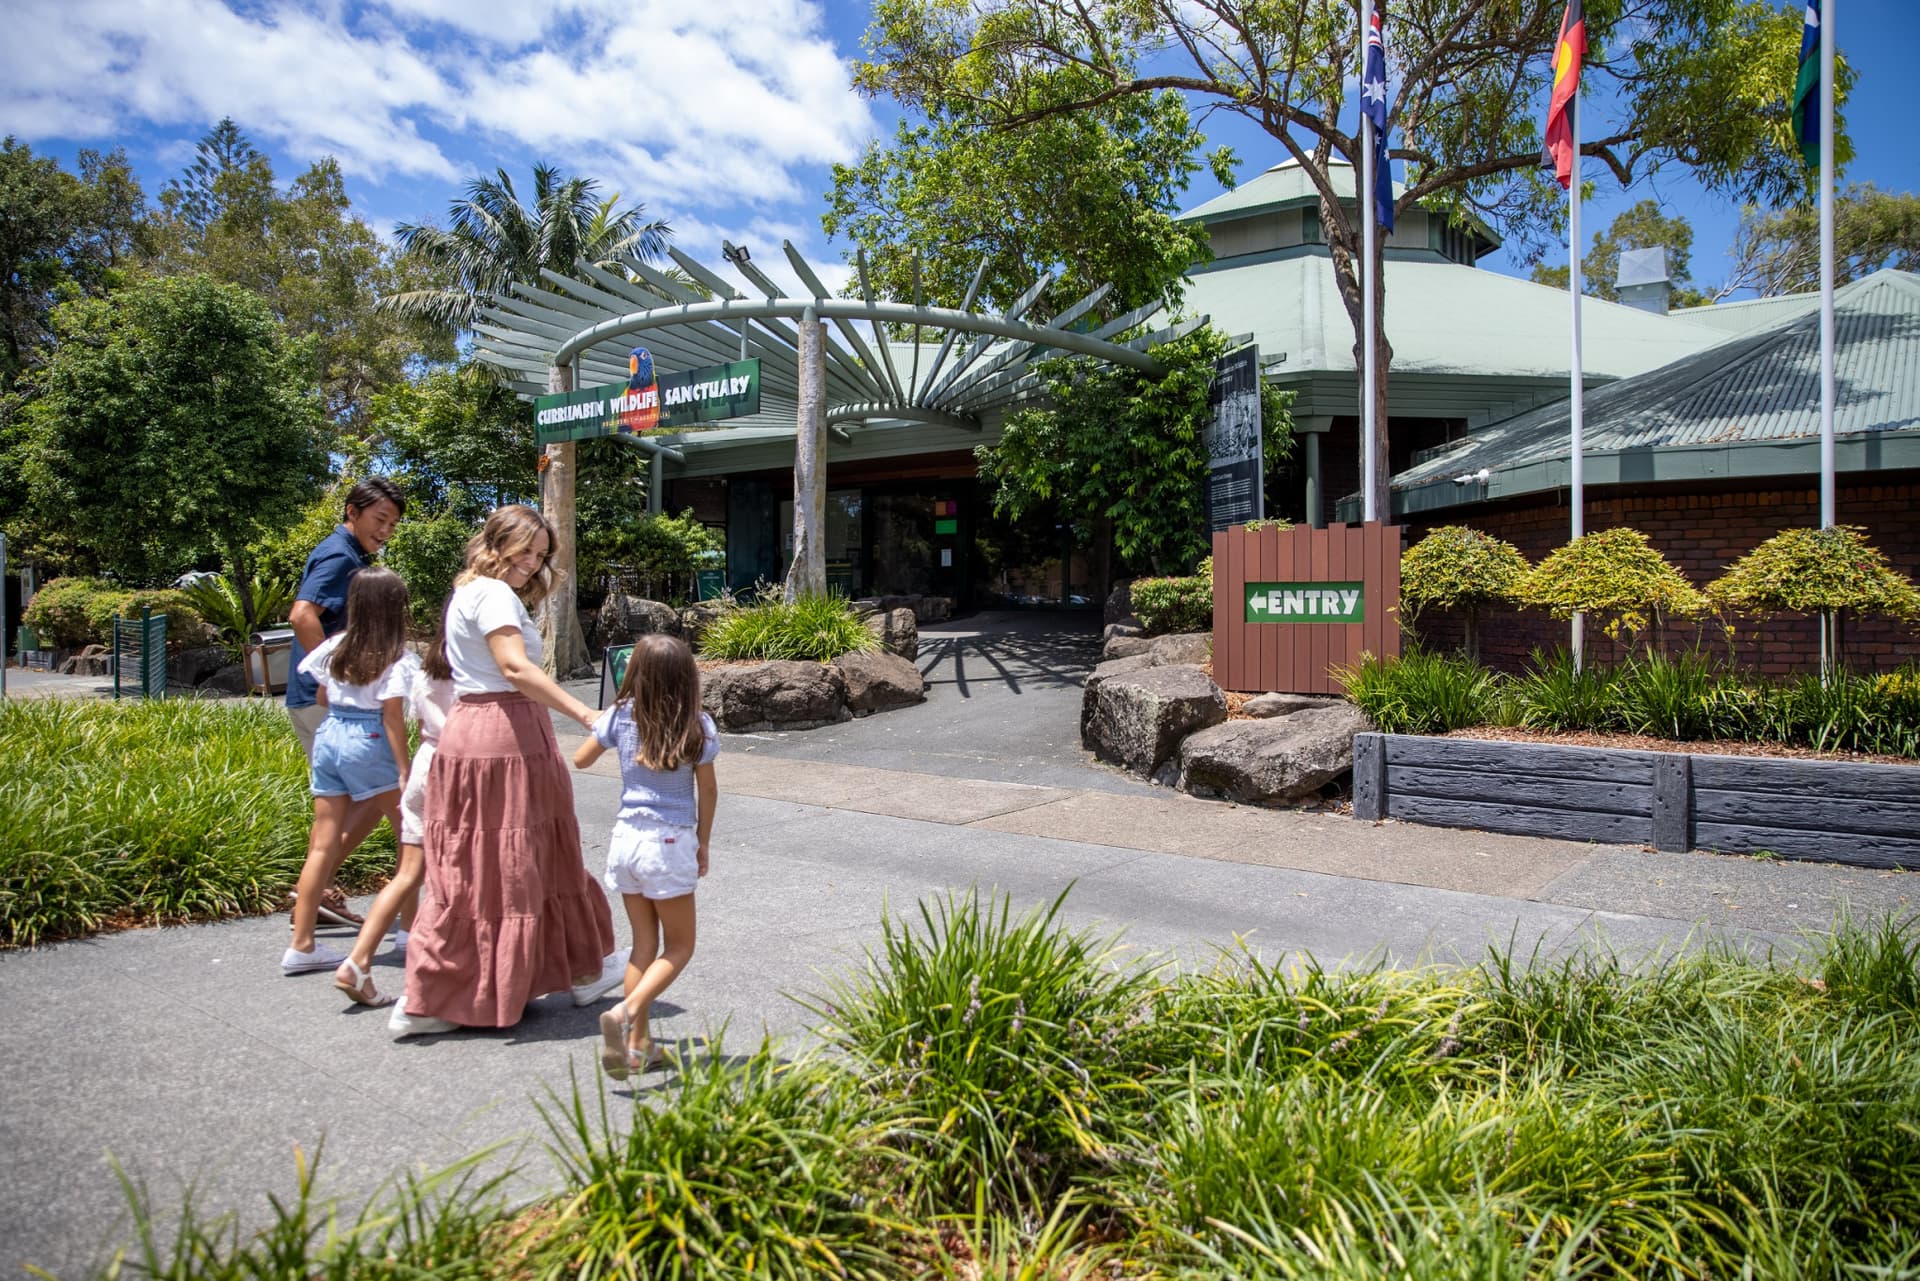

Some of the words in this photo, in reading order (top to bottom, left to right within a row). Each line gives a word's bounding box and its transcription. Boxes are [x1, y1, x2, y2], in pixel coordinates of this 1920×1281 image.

[537, 400, 604, 426] CURRUMBIN
[610, 390, 658, 414] WILDLIFE
[664, 375, 751, 406] SANCTUARY
[1267, 589, 1360, 615] ENTRY
